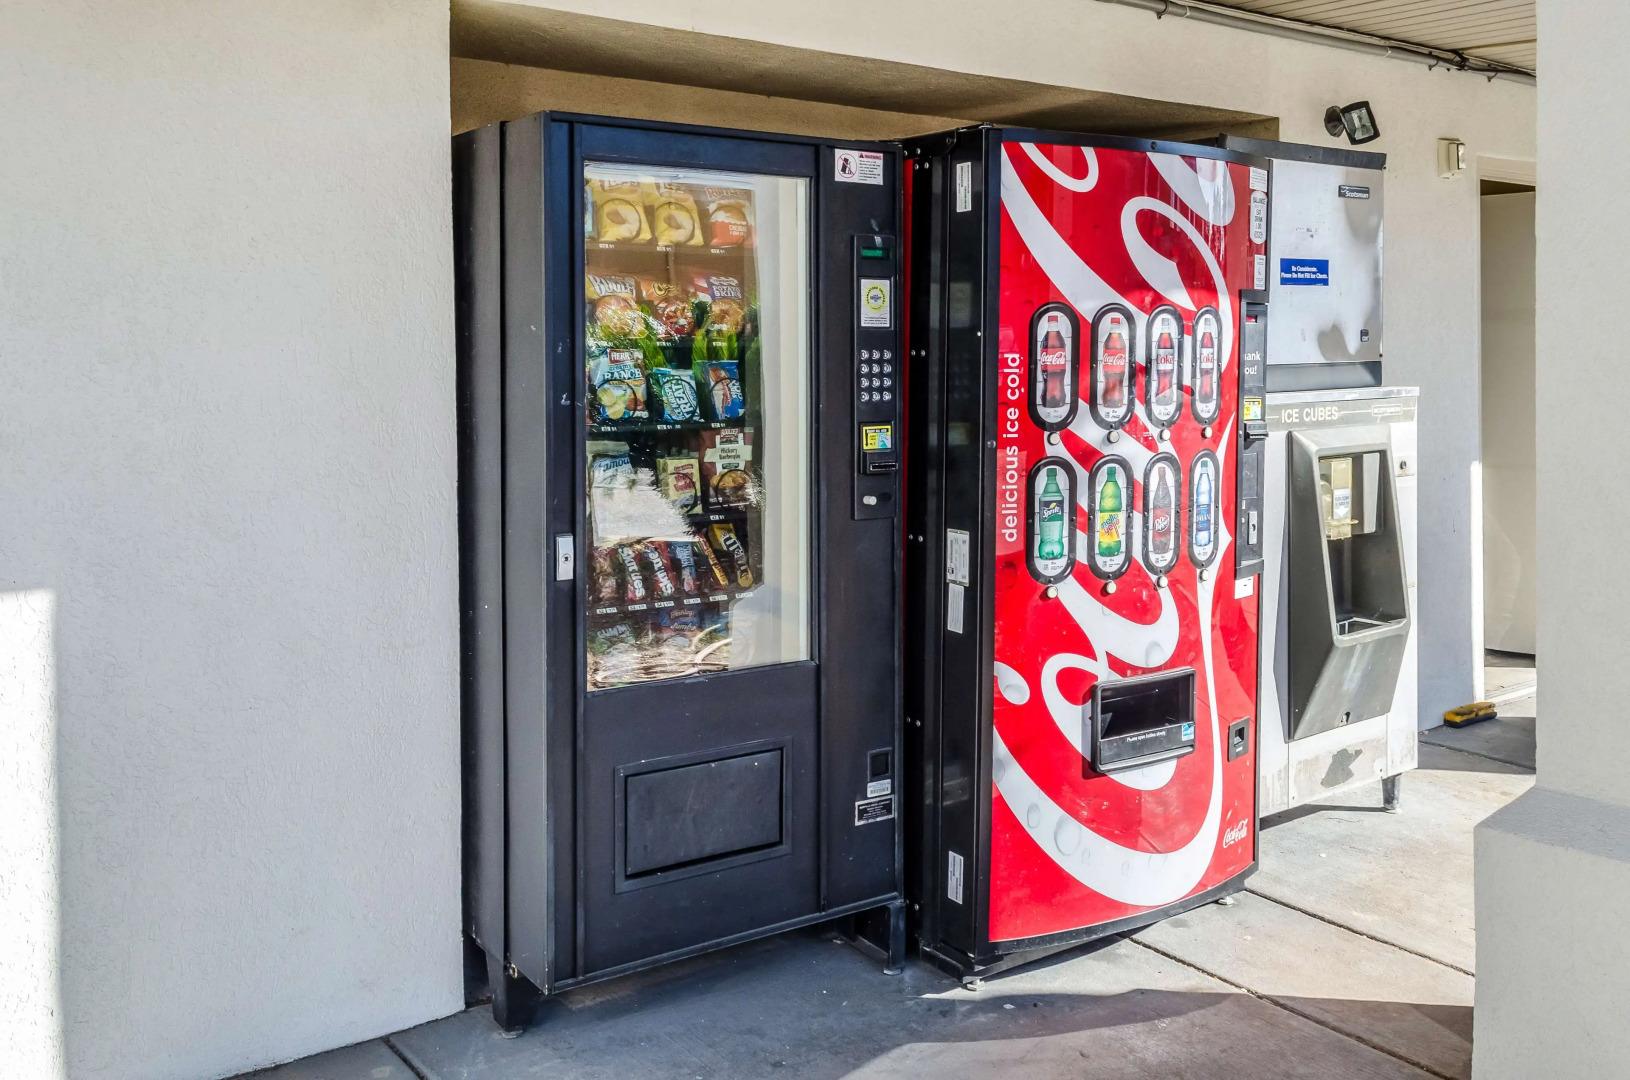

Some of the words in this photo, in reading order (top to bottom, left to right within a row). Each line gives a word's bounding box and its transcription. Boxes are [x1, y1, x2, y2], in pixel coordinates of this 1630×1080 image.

[714, 290, 742, 298] SKINS
[1041, 351, 1066, 366] Coca-Cola
[1103, 353, 1126, 366] Coca-Cola
[1156, 352, 1174, 364] Coke
[1200, 352, 1214, 364] Coke
[1245, 351, 1261, 361] ank
[604, 368, 642, 380] RANCH
[1244, 365, 1257, 375] ou!
[1003, 354, 1020, 400] cold
[1282, 408, 1299, 423] ICE
[1303, 406, 1338, 422] CUBES
[1002, 407, 1019, 438] ice
[1002, 445, 1018, 542] delicious
[1042, 506, 1062, 518] Sprite
[1101, 514, 1118, 530] mello
[1223, 818, 1249, 848] Coca-Cola
